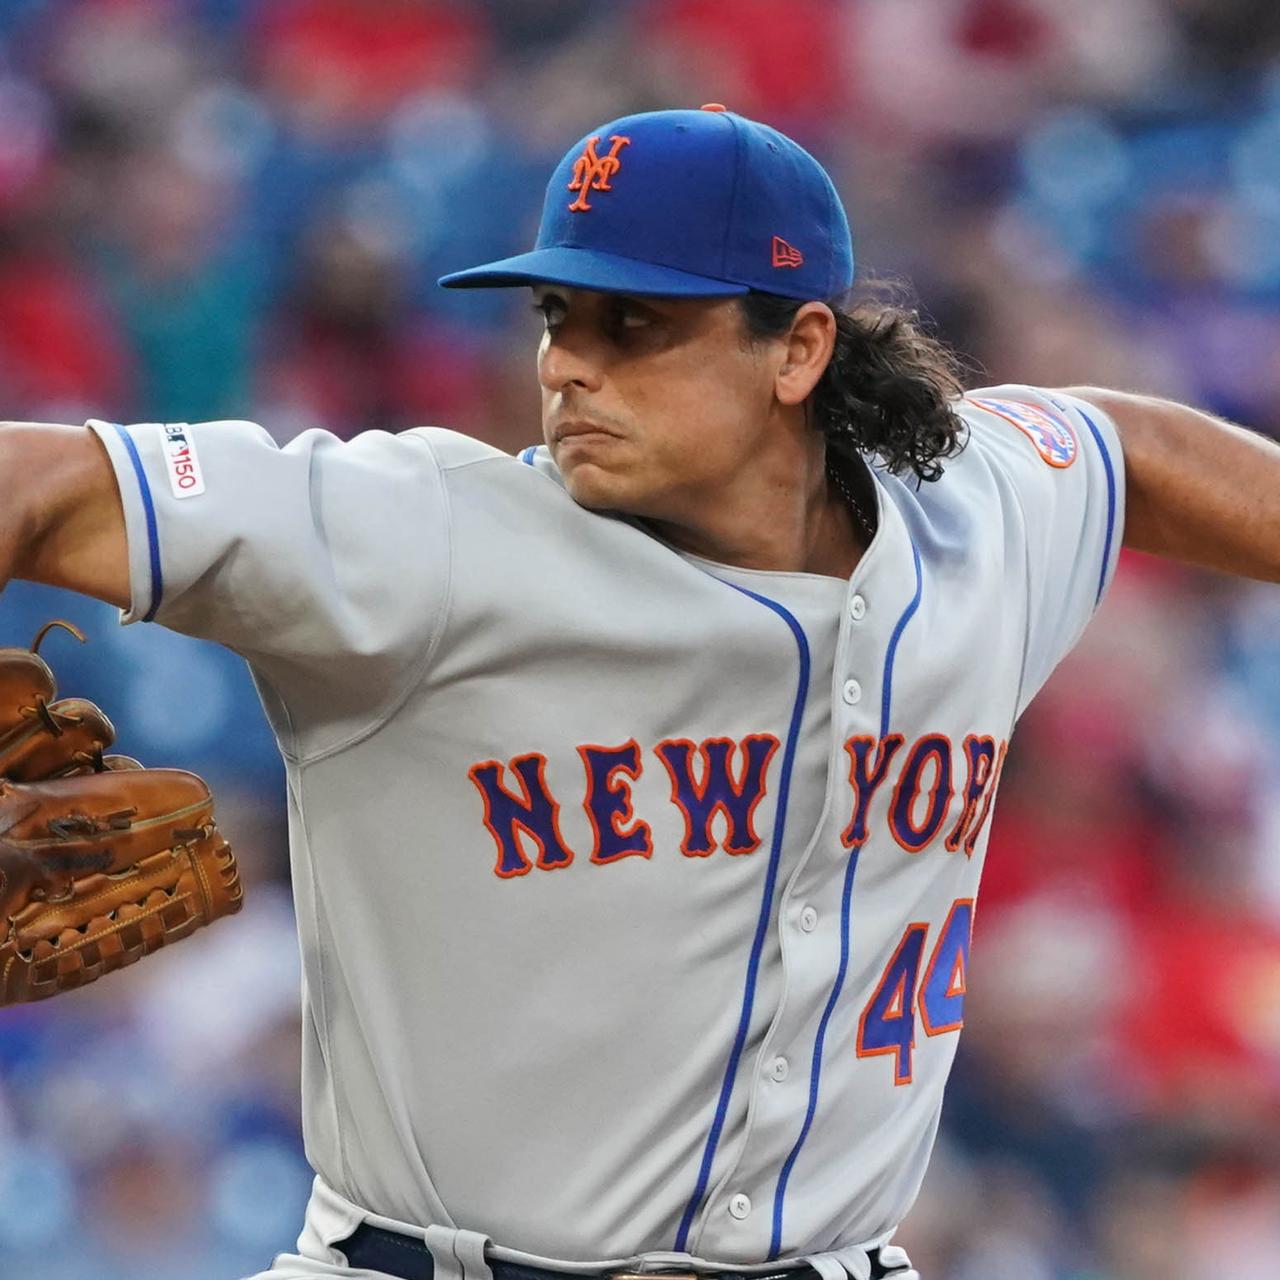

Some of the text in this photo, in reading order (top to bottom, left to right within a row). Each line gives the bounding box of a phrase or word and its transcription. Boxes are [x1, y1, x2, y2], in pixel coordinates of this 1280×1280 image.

[174, 456, 196, 488] 150
[468, 732, 1008, 879] NEW YOR
[856, 897, 975, 1087] 44
